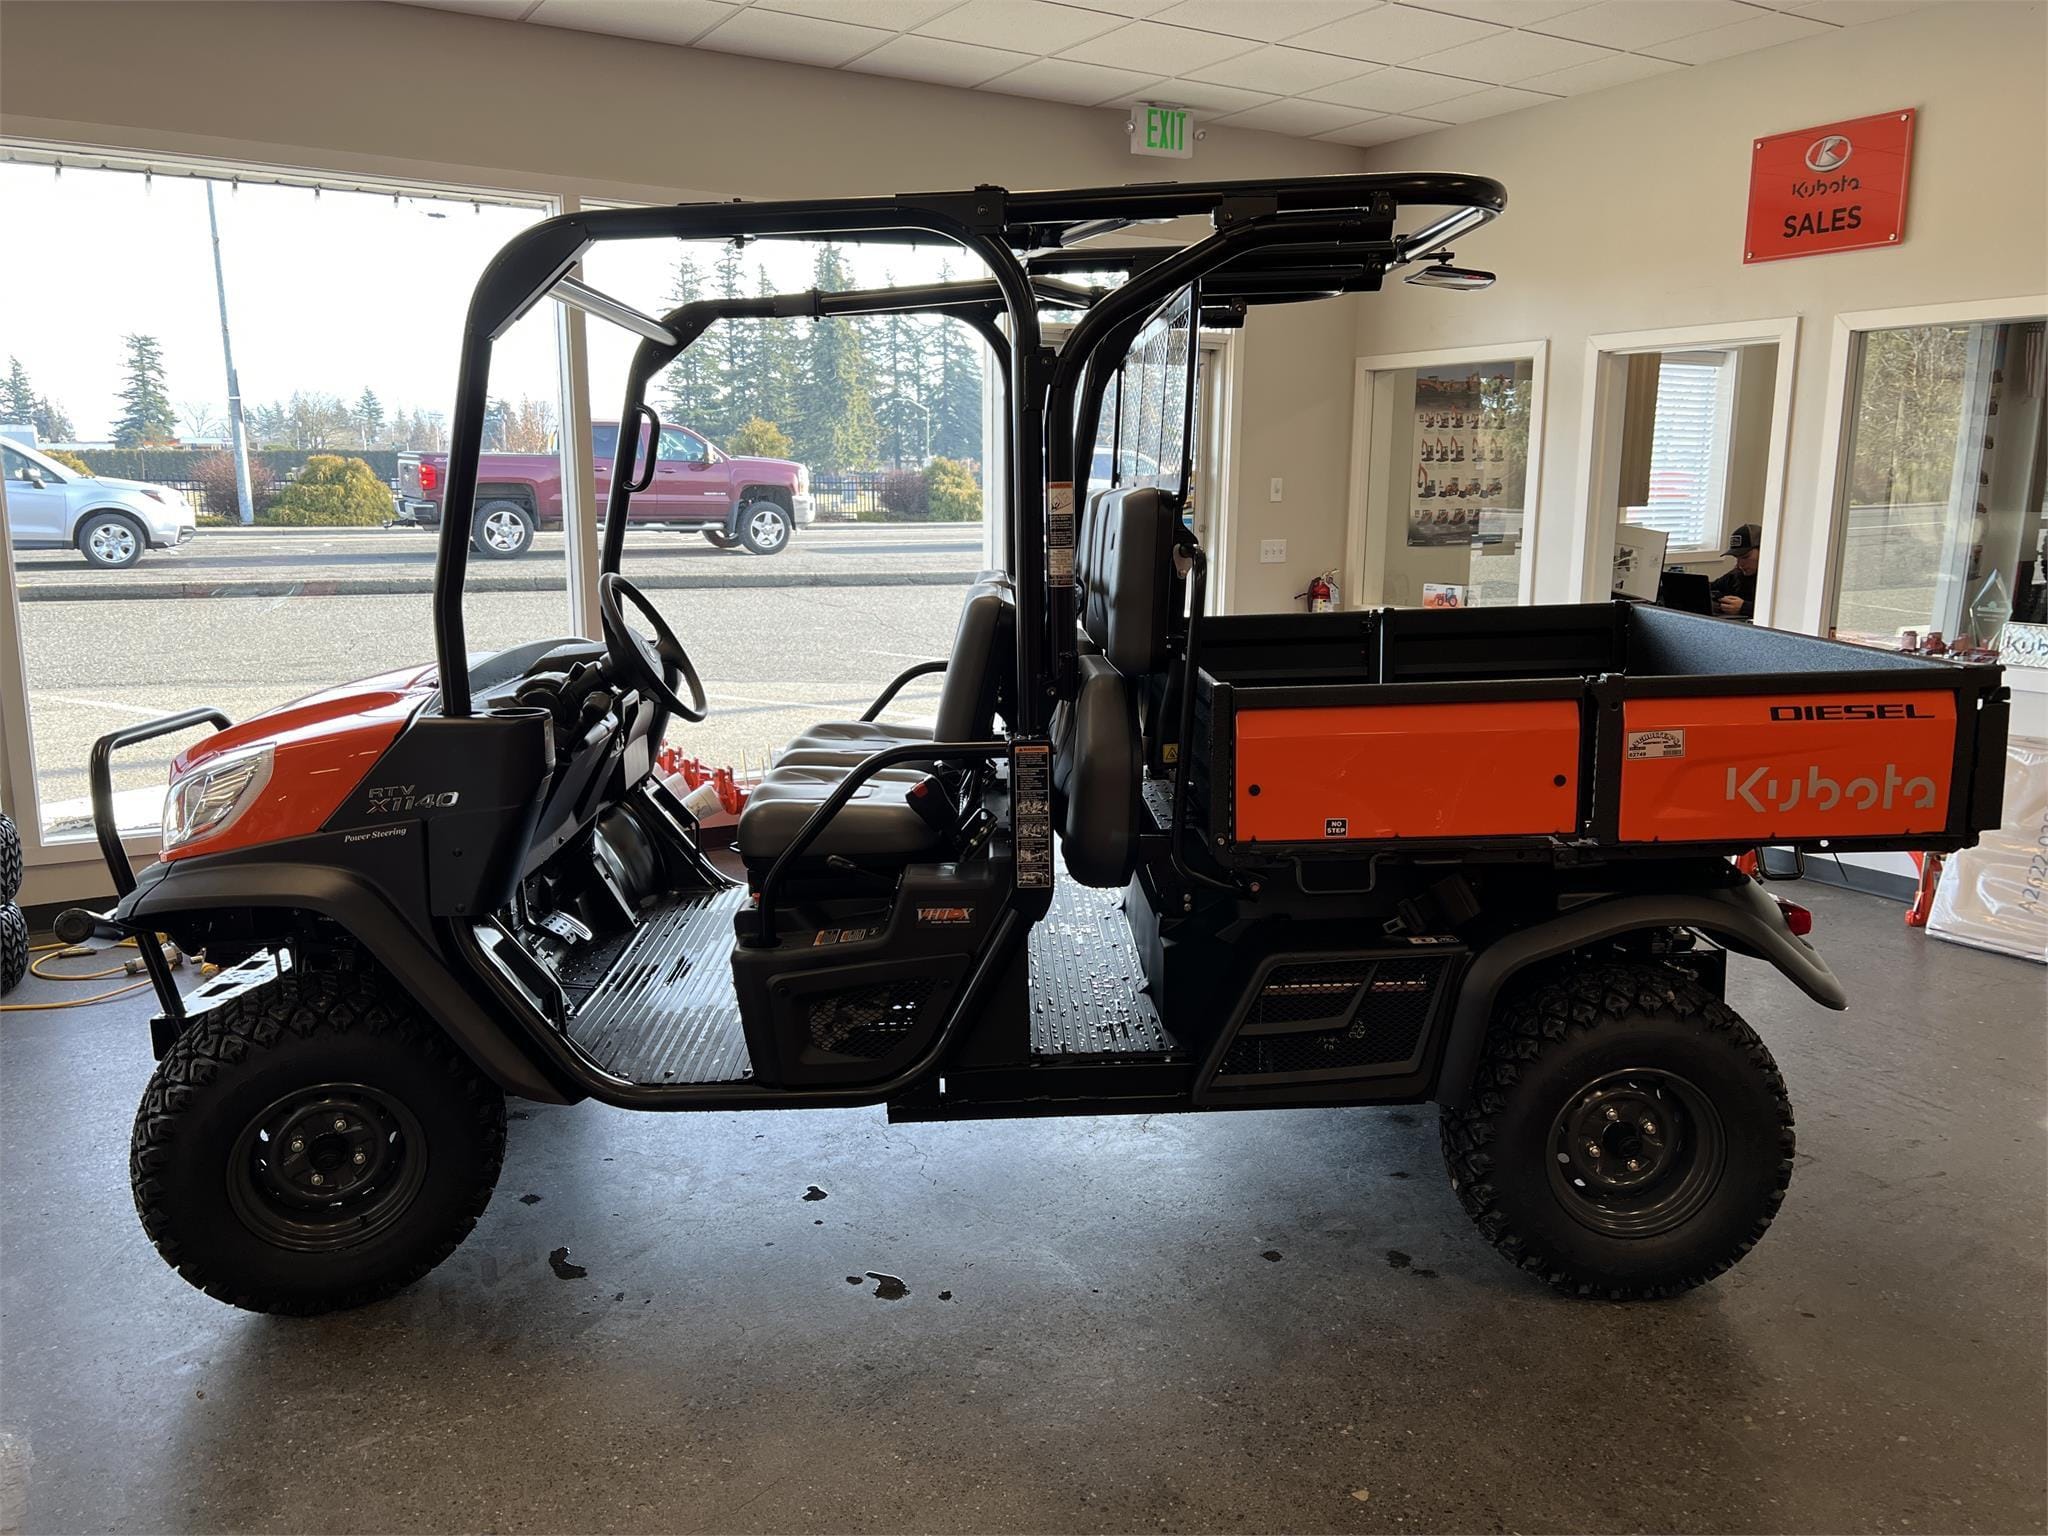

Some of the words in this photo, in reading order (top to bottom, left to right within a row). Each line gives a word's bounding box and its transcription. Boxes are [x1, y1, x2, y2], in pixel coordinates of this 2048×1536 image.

[1146, 108, 1186, 151] EXIT
[1791, 175, 1861, 198] Kubota
[1783, 205, 1862, 238] SALES
[1770, 703, 1935, 721] DIESEL
[368, 784, 415, 798] RTV
[1725, 764, 1936, 813] Kubota
[366, 791, 459, 814] X1140
[344, 833, 371, 843] Power
[372, 828, 407, 839] Steering
